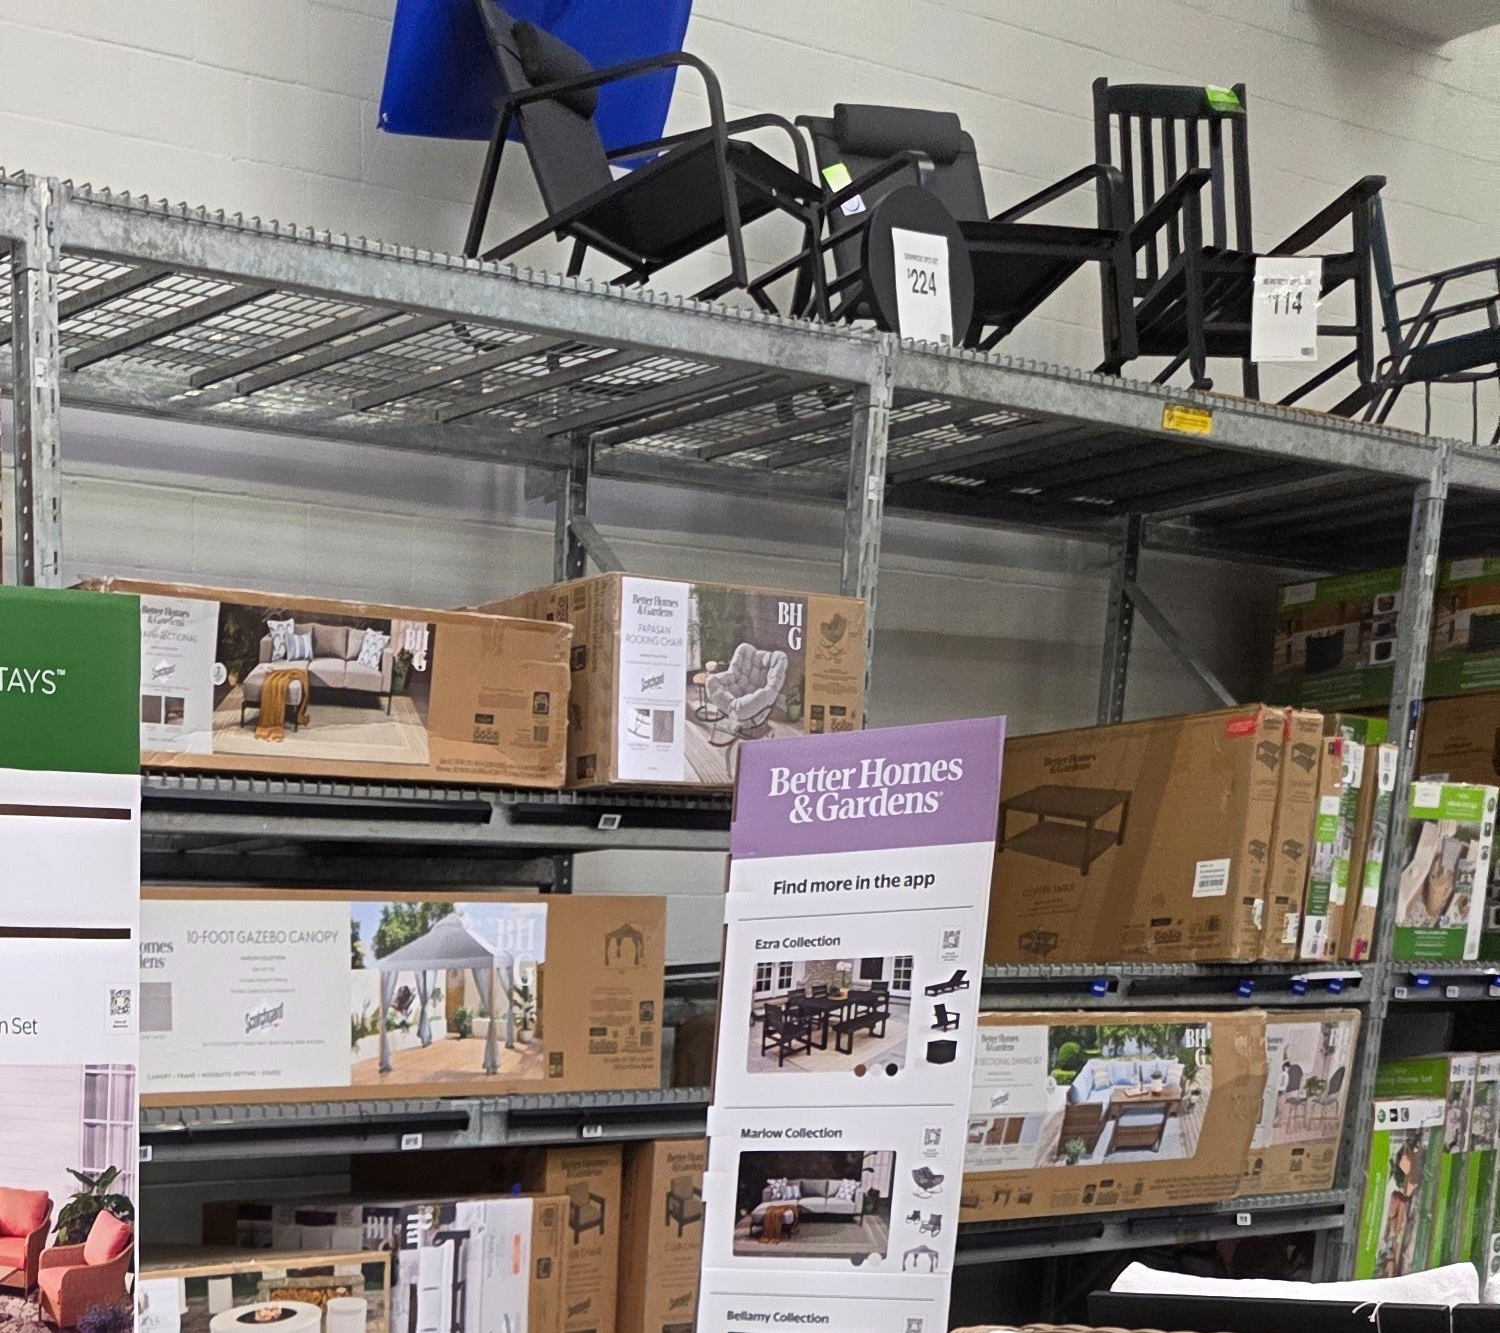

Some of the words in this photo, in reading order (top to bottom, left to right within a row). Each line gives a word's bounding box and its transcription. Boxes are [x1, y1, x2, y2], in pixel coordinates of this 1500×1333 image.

[778, 601, 803, 626] BH
[788, 627, 802, 650] G
[768, 765, 856, 797] Better
[857, 758, 963, 790] Homes
[773, 878, 807, 895] Find
[810, 877, 853, 893] more
[855, 874, 870, 890] in
[874, 874, 901, 889] the
[904, 873, 936, 889] app
[186, 930, 235, 945] 10-FOOT
[237, 930, 287, 944] GAZEBO
[288, 930, 339, 944] CANOPY
[755, 939, 780, 950] Ezra
[782, 936, 841, 949] Collection
[11, 1017, 39, 1035] Set
[740, 1128, 783, 1139] Marlow
[784, 1127, 842, 1139] Collection
[726, 1311, 771, 1323] Bellamy
[773, 1311, 829, 1324] Collection
